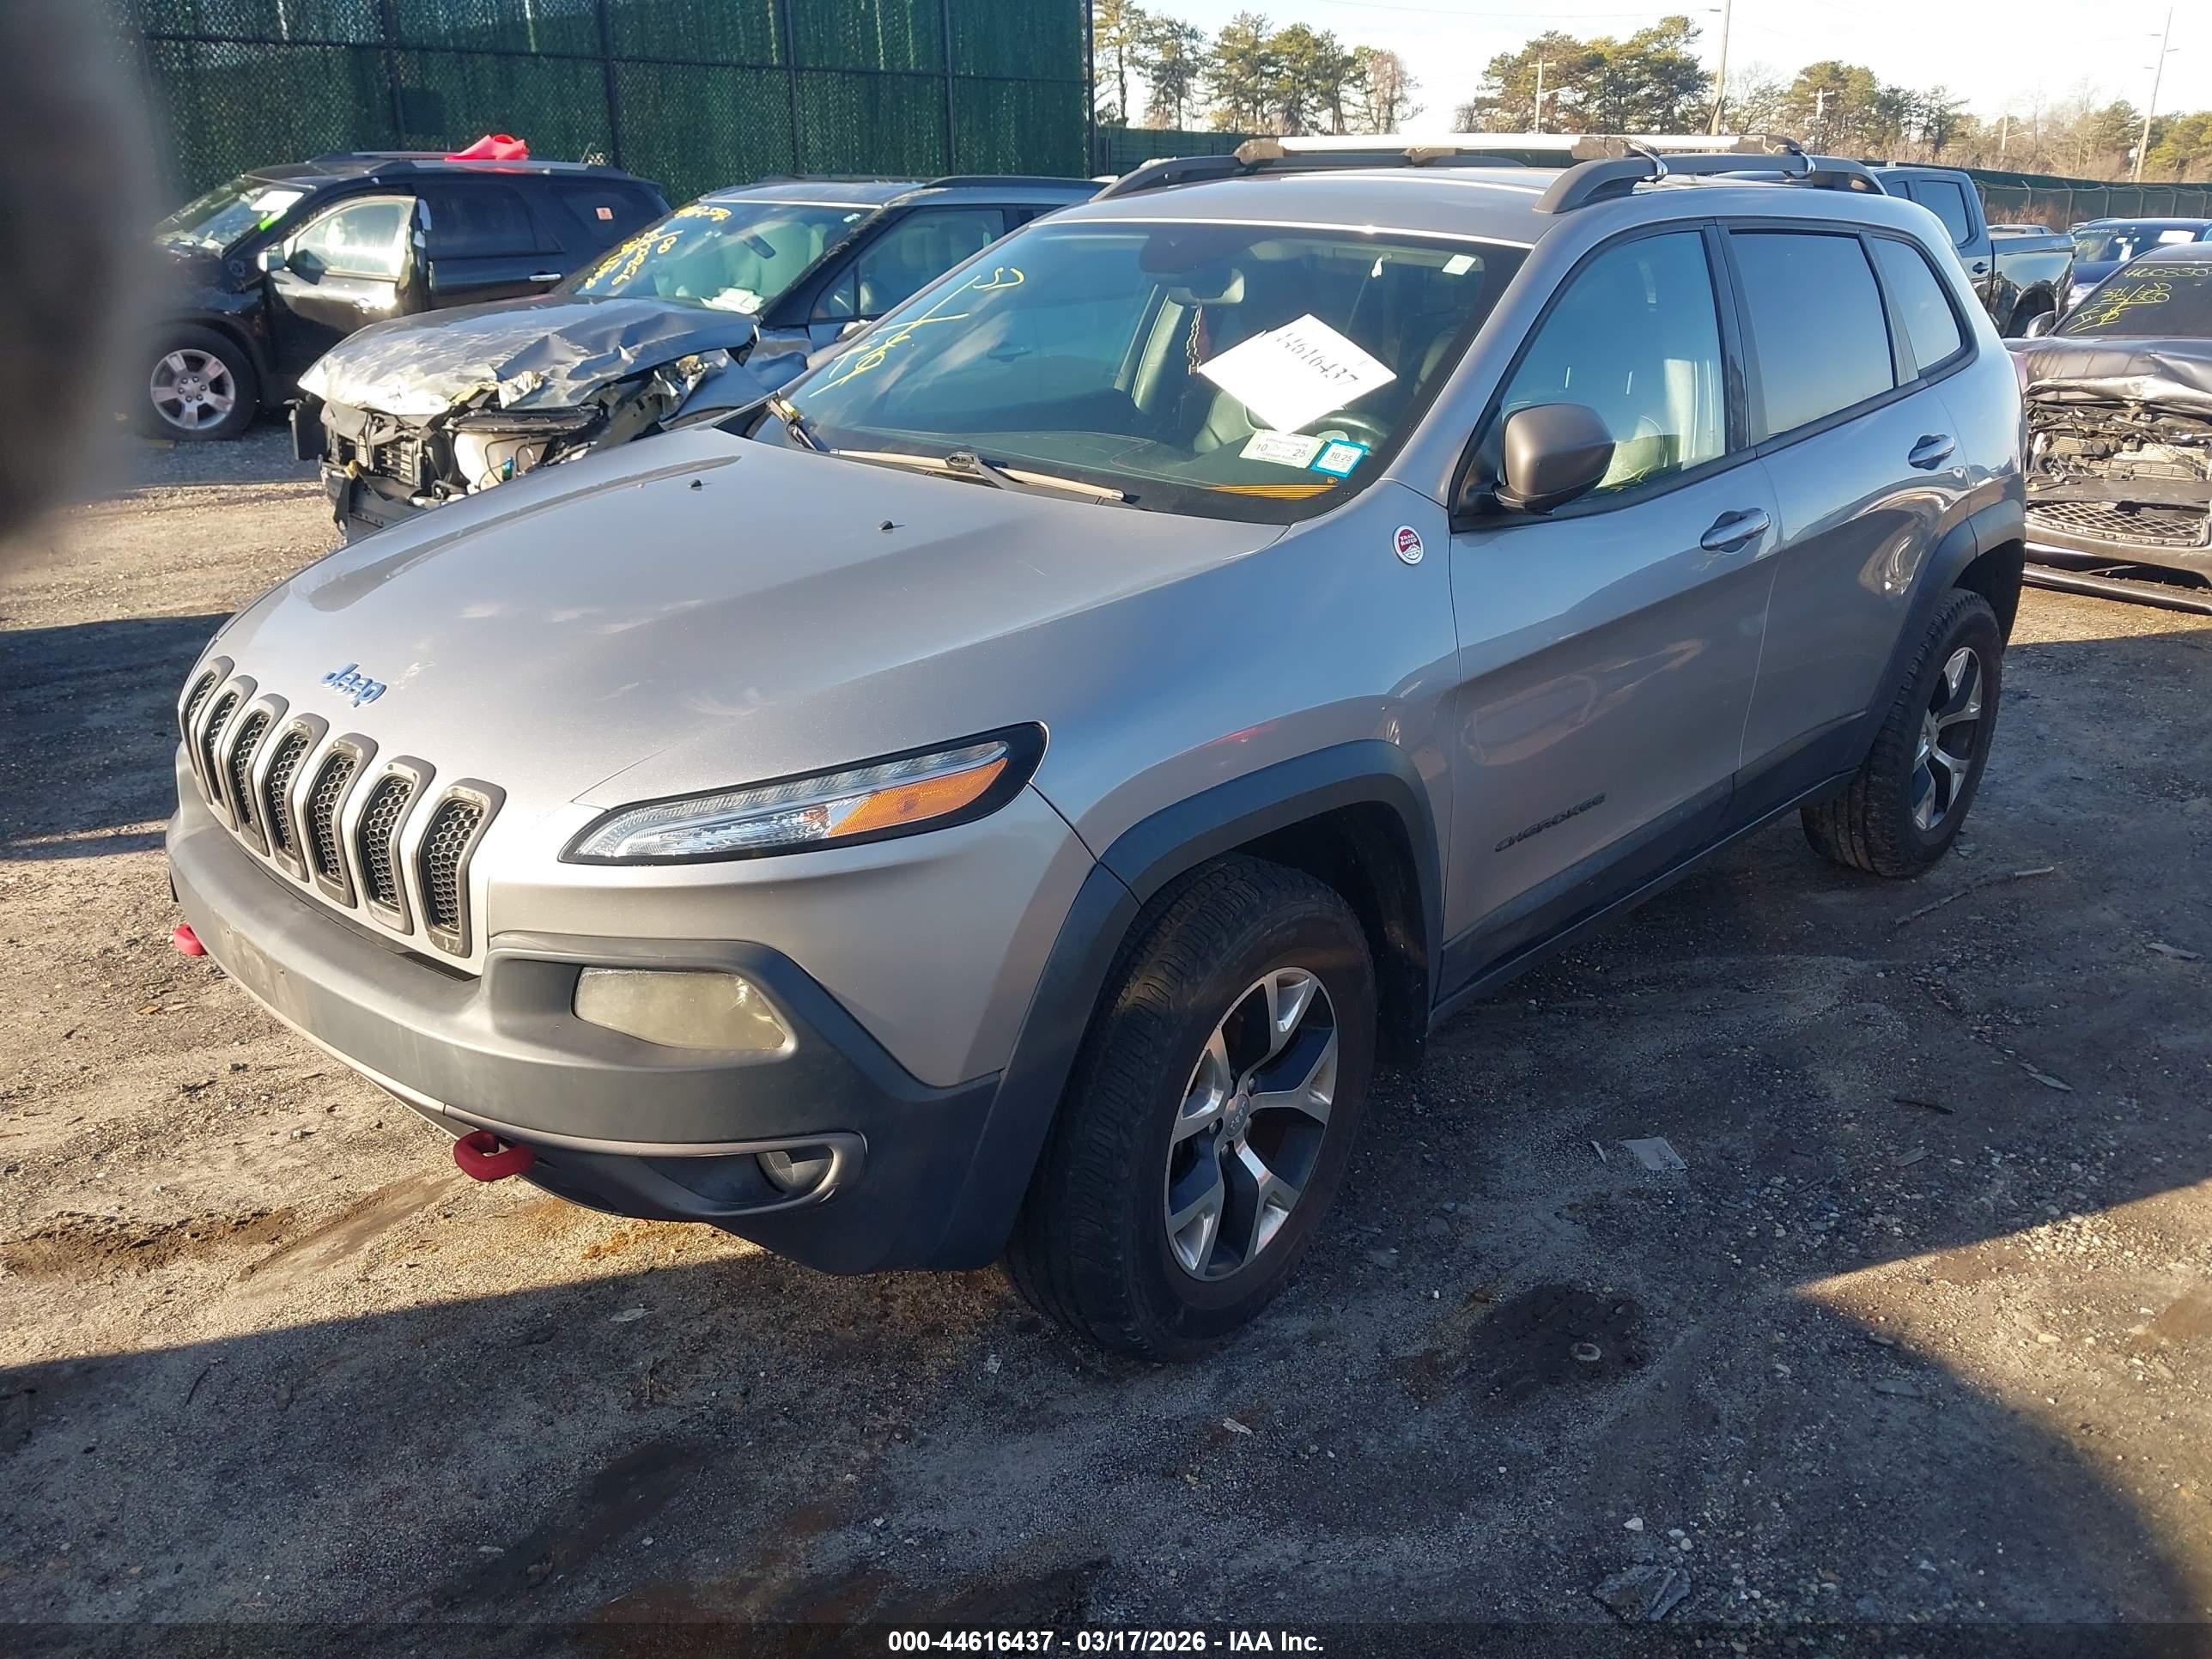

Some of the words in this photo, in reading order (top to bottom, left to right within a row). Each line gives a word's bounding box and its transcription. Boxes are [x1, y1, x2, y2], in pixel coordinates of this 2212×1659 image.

[1256, 442, 1268, 452] 10
[1292, 448, 1306, 458] 25
[320, 662, 387, 708] Jeep
